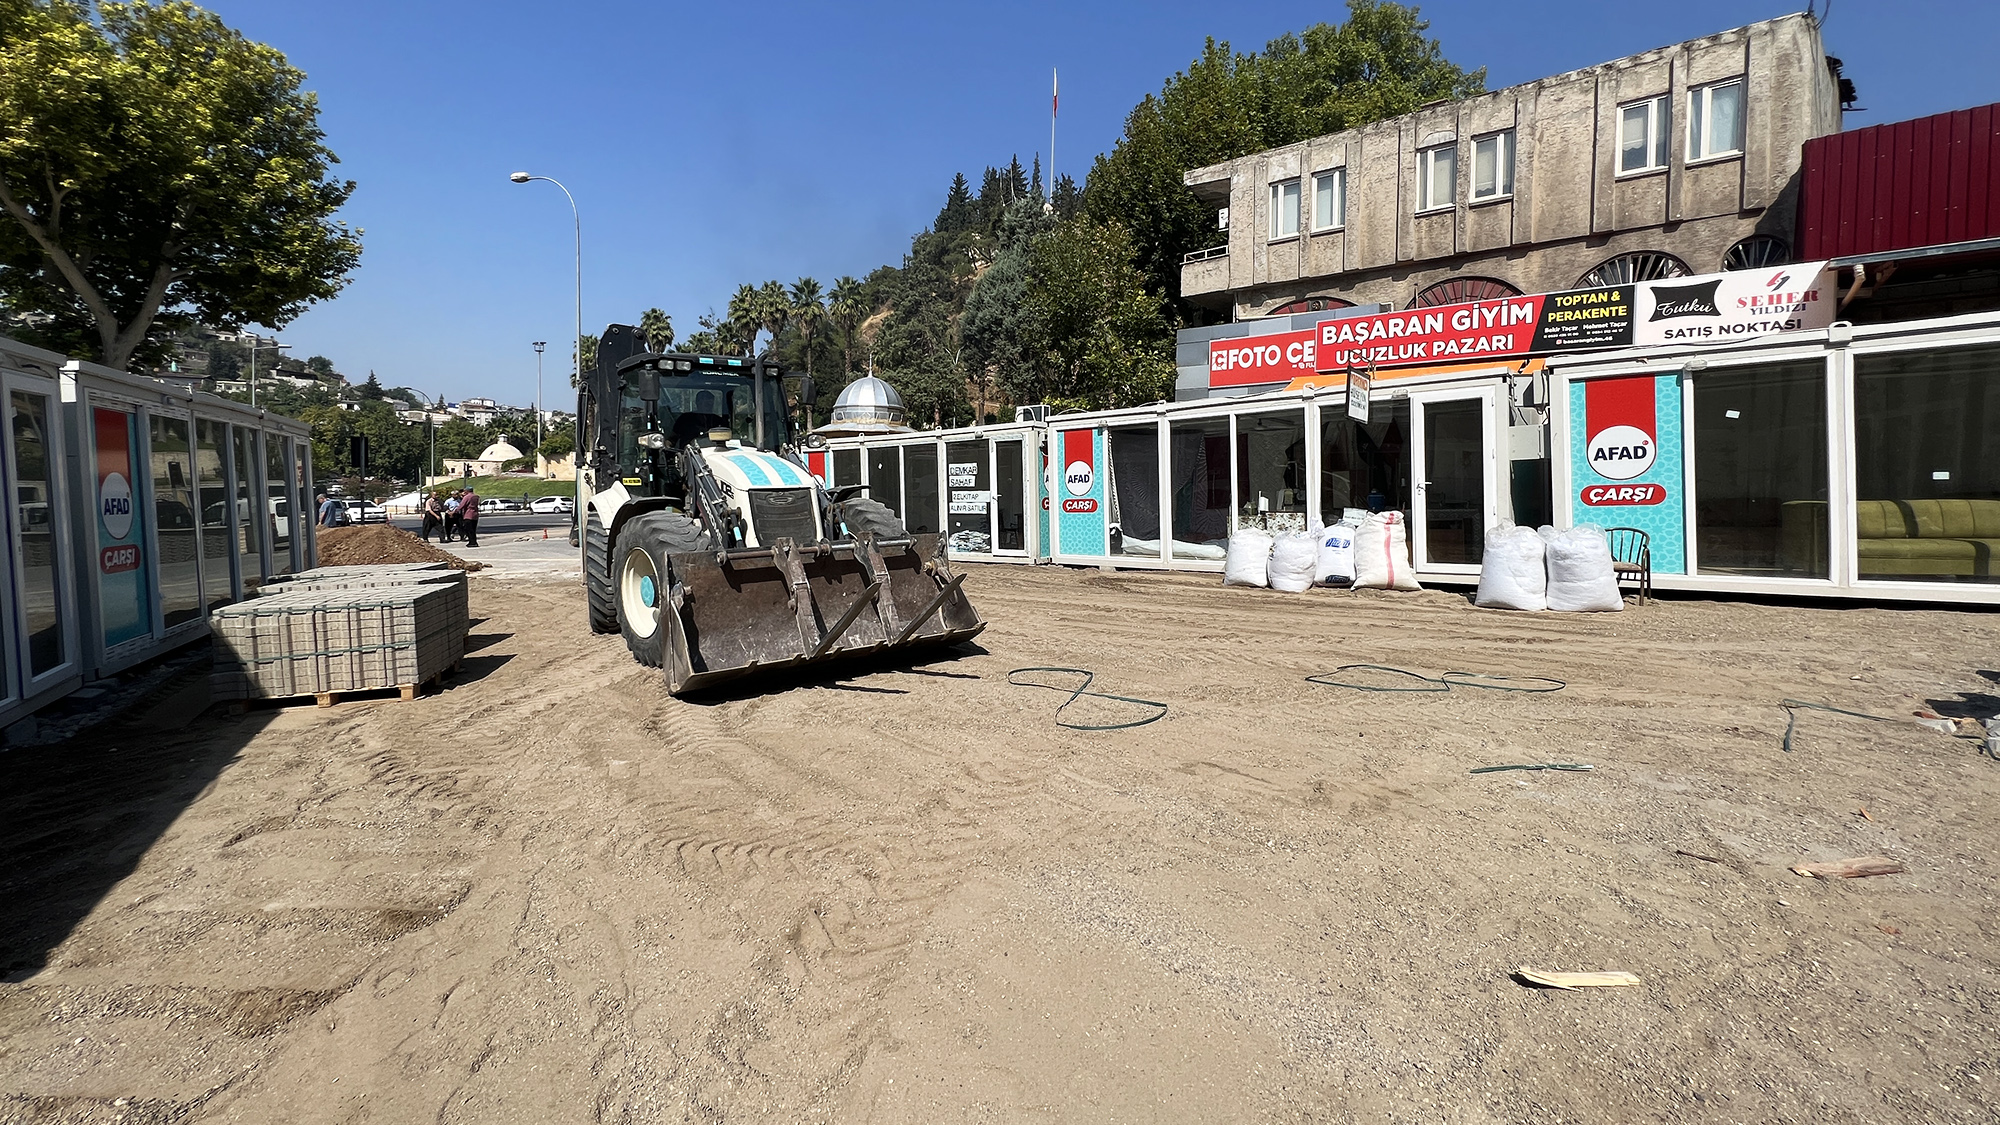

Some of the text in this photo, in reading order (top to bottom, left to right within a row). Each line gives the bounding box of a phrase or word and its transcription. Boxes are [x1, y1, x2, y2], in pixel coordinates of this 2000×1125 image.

[1555, 290, 1621, 307] TOPTAN &
[1656, 298, 1714, 316] Tutku
[1736, 290, 1819, 309] SEHER
[1548, 305, 1628, 323] PERAKENTE
[1750, 303, 1807, 316] YILDIZI
[1322, 300, 1533, 345] BAŞARAN GİYİM
[1664, 319, 1801, 339] SATIŞ NOKTASI
[1228, 344, 1282, 370] FOTO
[1336, 334, 1514, 365] UCUZLUK PAZARI
[1593, 445, 1647, 461] AFAD
[1067, 474, 1090, 484] AFAD
[1589, 487, 1655, 503] ÇARŞI
[104, 498, 130, 515] AFAD
[1065, 500, 1093, 511] ÇARŞI
[104, 548, 136, 569] ÇARŞI
